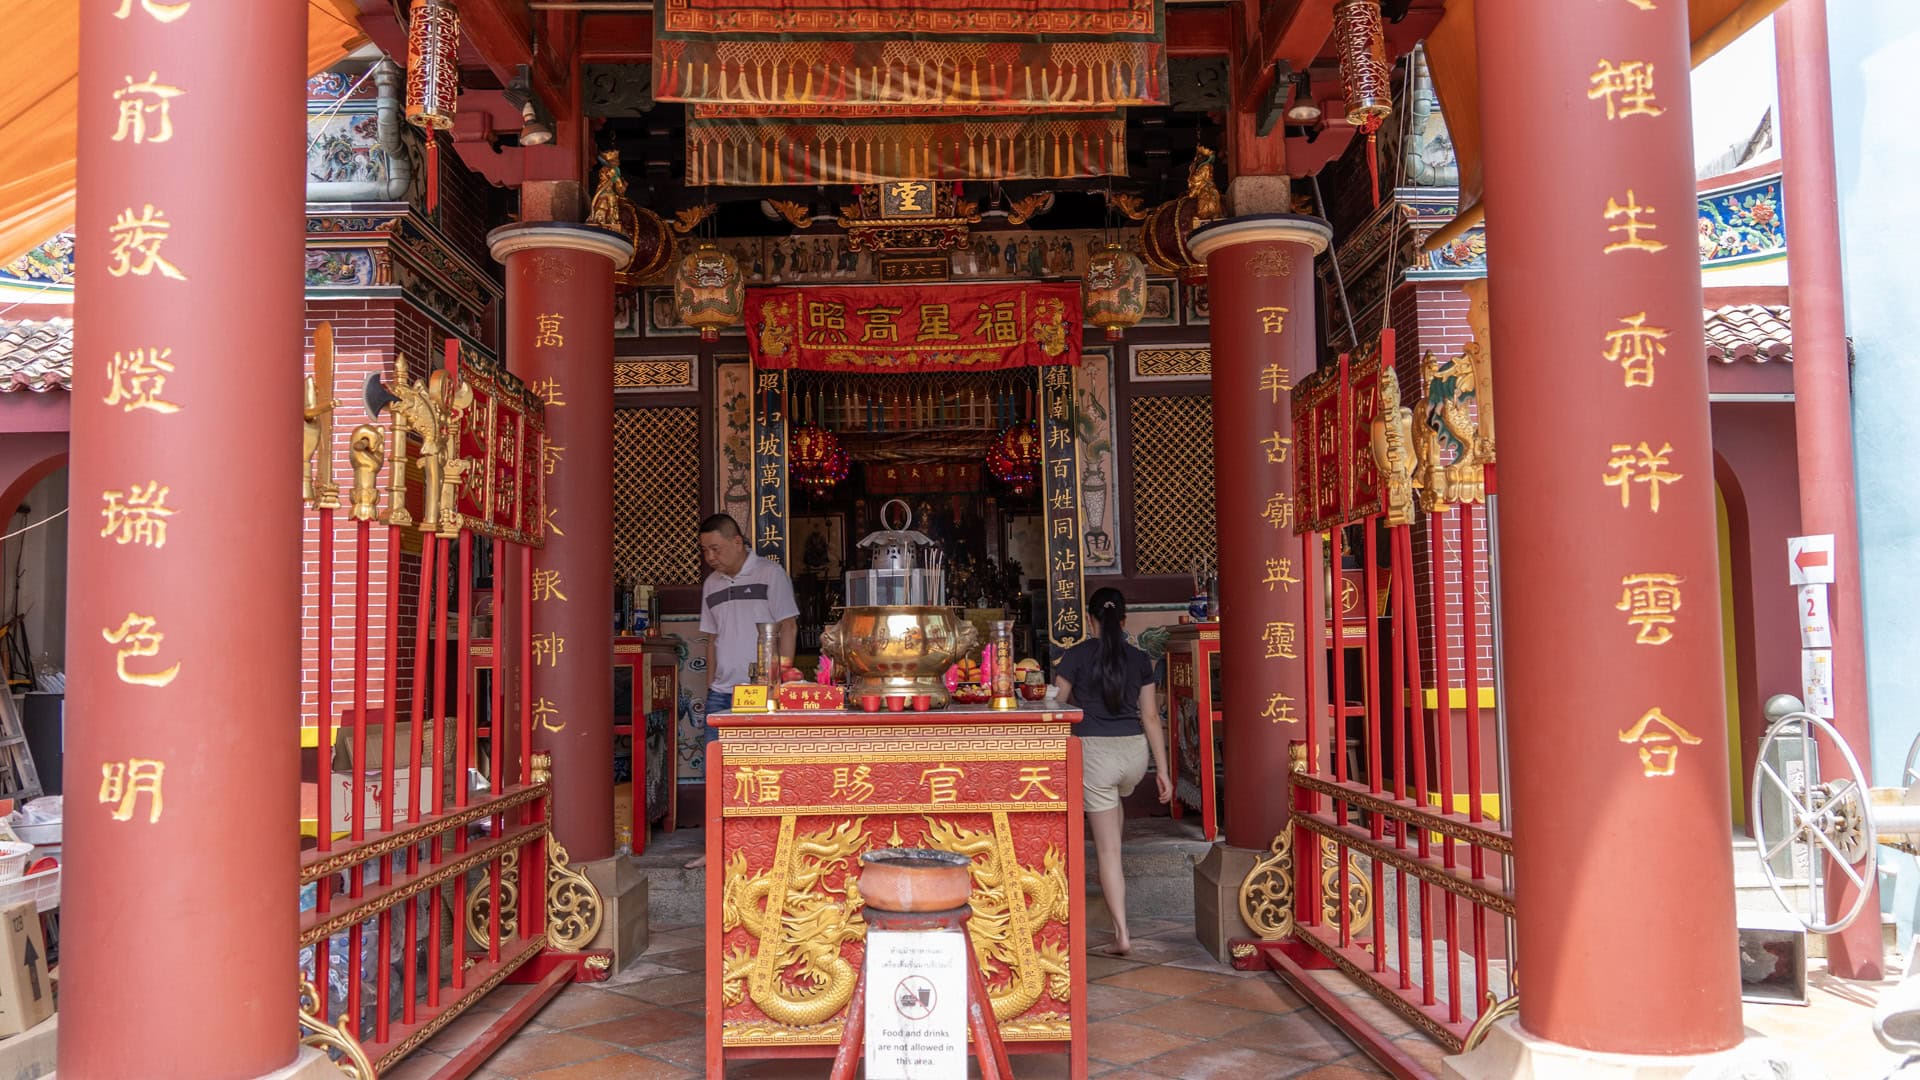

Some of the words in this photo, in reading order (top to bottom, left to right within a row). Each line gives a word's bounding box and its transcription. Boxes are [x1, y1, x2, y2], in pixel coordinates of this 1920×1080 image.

[1806, 598, 1816, 617] 2
[882, 1029, 903, 1038] Food
[905, 1029, 921, 1038] and
[924, 1029, 949, 1038] drinks
[894, 1043, 908, 1052] not
[910, 1042, 944, 1052] allowed
[946, 1043, 954, 1052] in
[896, 1057, 912, 1066] this
